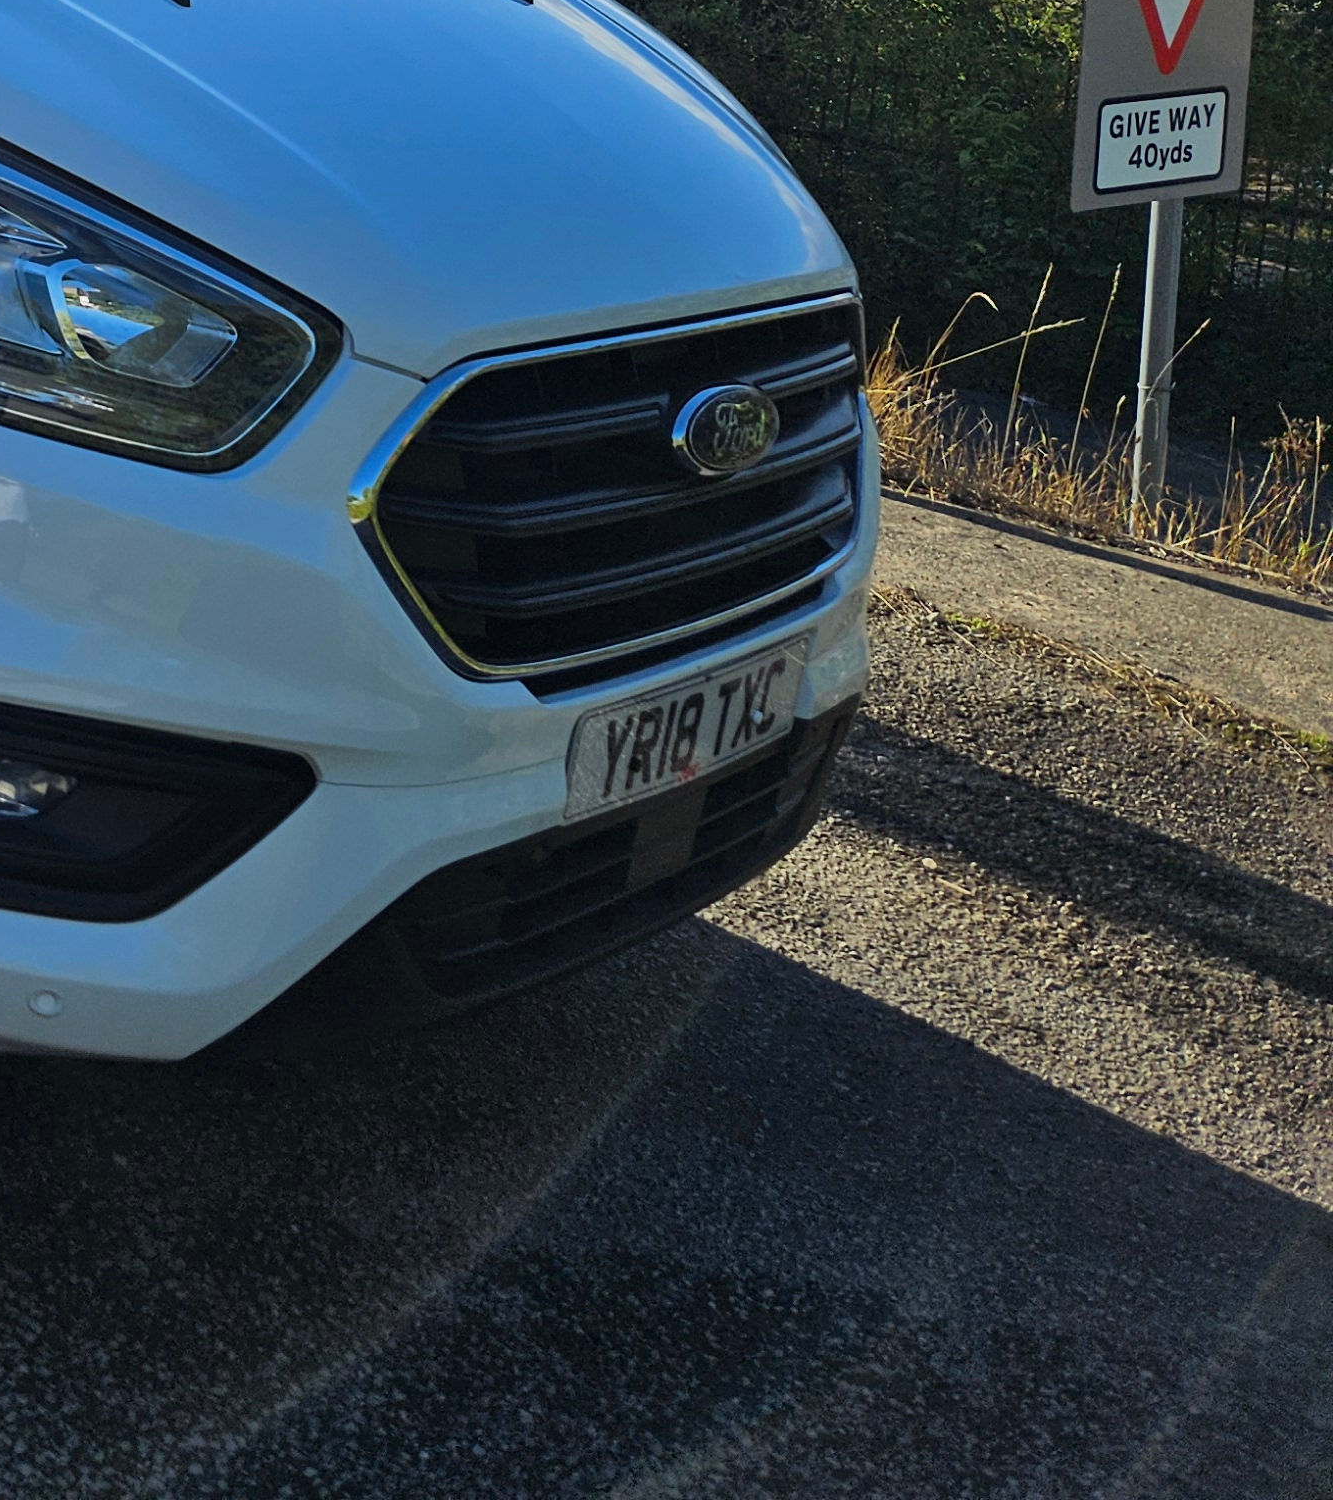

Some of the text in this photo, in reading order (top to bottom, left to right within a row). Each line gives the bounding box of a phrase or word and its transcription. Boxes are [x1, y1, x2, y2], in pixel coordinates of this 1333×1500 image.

[1109, 102, 1216, 139] GIVE WAY
[1128, 139, 1193, 171] 40yds
[603, 658, 786, 798] YR18 TXC
